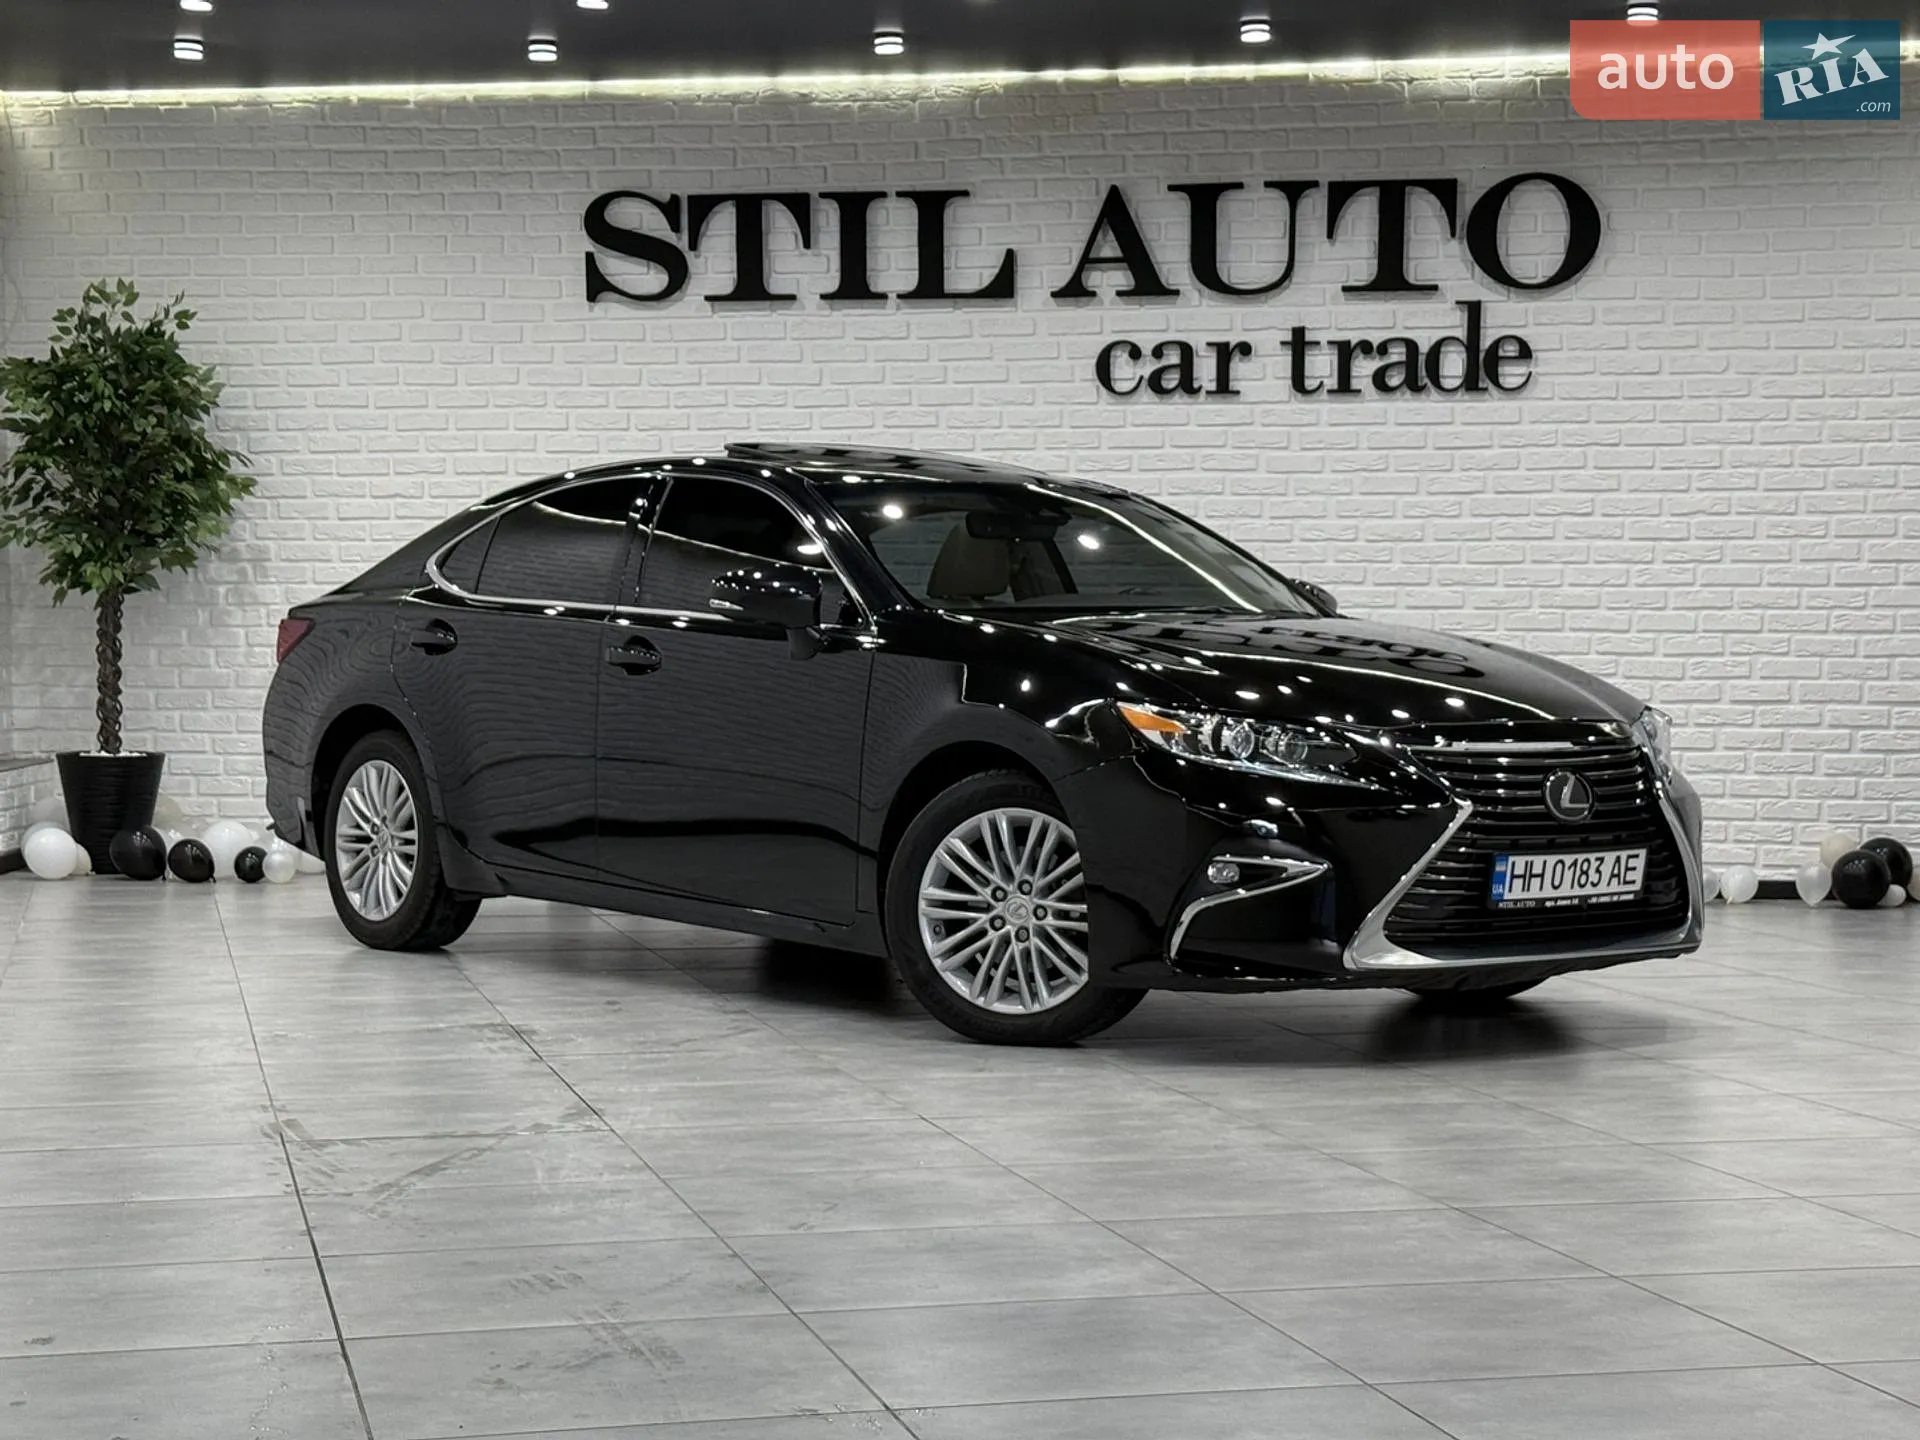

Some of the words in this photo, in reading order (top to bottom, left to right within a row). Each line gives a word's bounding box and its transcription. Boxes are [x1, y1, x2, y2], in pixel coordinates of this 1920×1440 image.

[583, 189, 1017, 303] STIL
[1050, 171, 1602, 298] AUTO
[1095, 340, 1253, 397] car
[1279, 300, 1533, 396] trade
[1508, 860, 1547, 893] HH
[1550, 856, 1605, 890] 0183
[1606, 853, 1640, 887] AE
